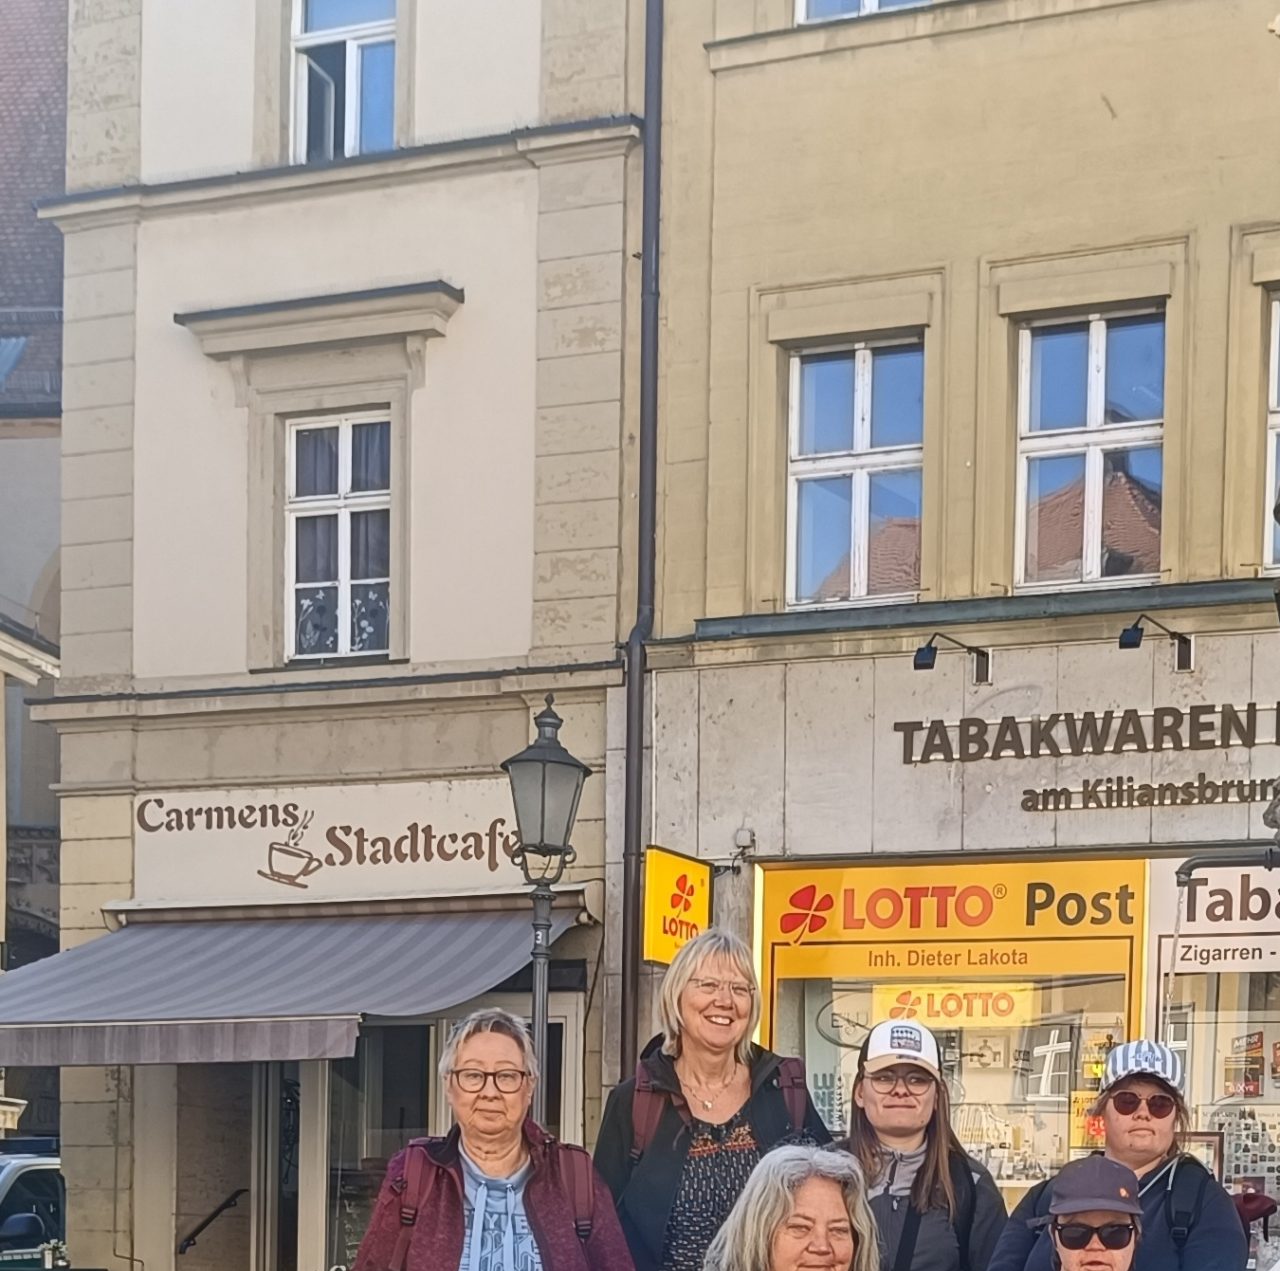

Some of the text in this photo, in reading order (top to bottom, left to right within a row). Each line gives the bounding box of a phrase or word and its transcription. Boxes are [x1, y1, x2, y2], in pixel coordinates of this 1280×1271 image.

[893, 702, 1257, 764] TABAKWAREN
[1020, 788, 1072, 811] am
[136, 798, 300, 833] Carmens
[1025, 882, 1135, 926] Post
[535, 930, 542, 944] 3
[662, 915, 699, 941] LOTTO
[868, 948, 1028, 967] Inh. Dieter Lakota
[1180, 945, 1263, 965] Zigarren
[926, 992, 1015, 1018] LOTTO
